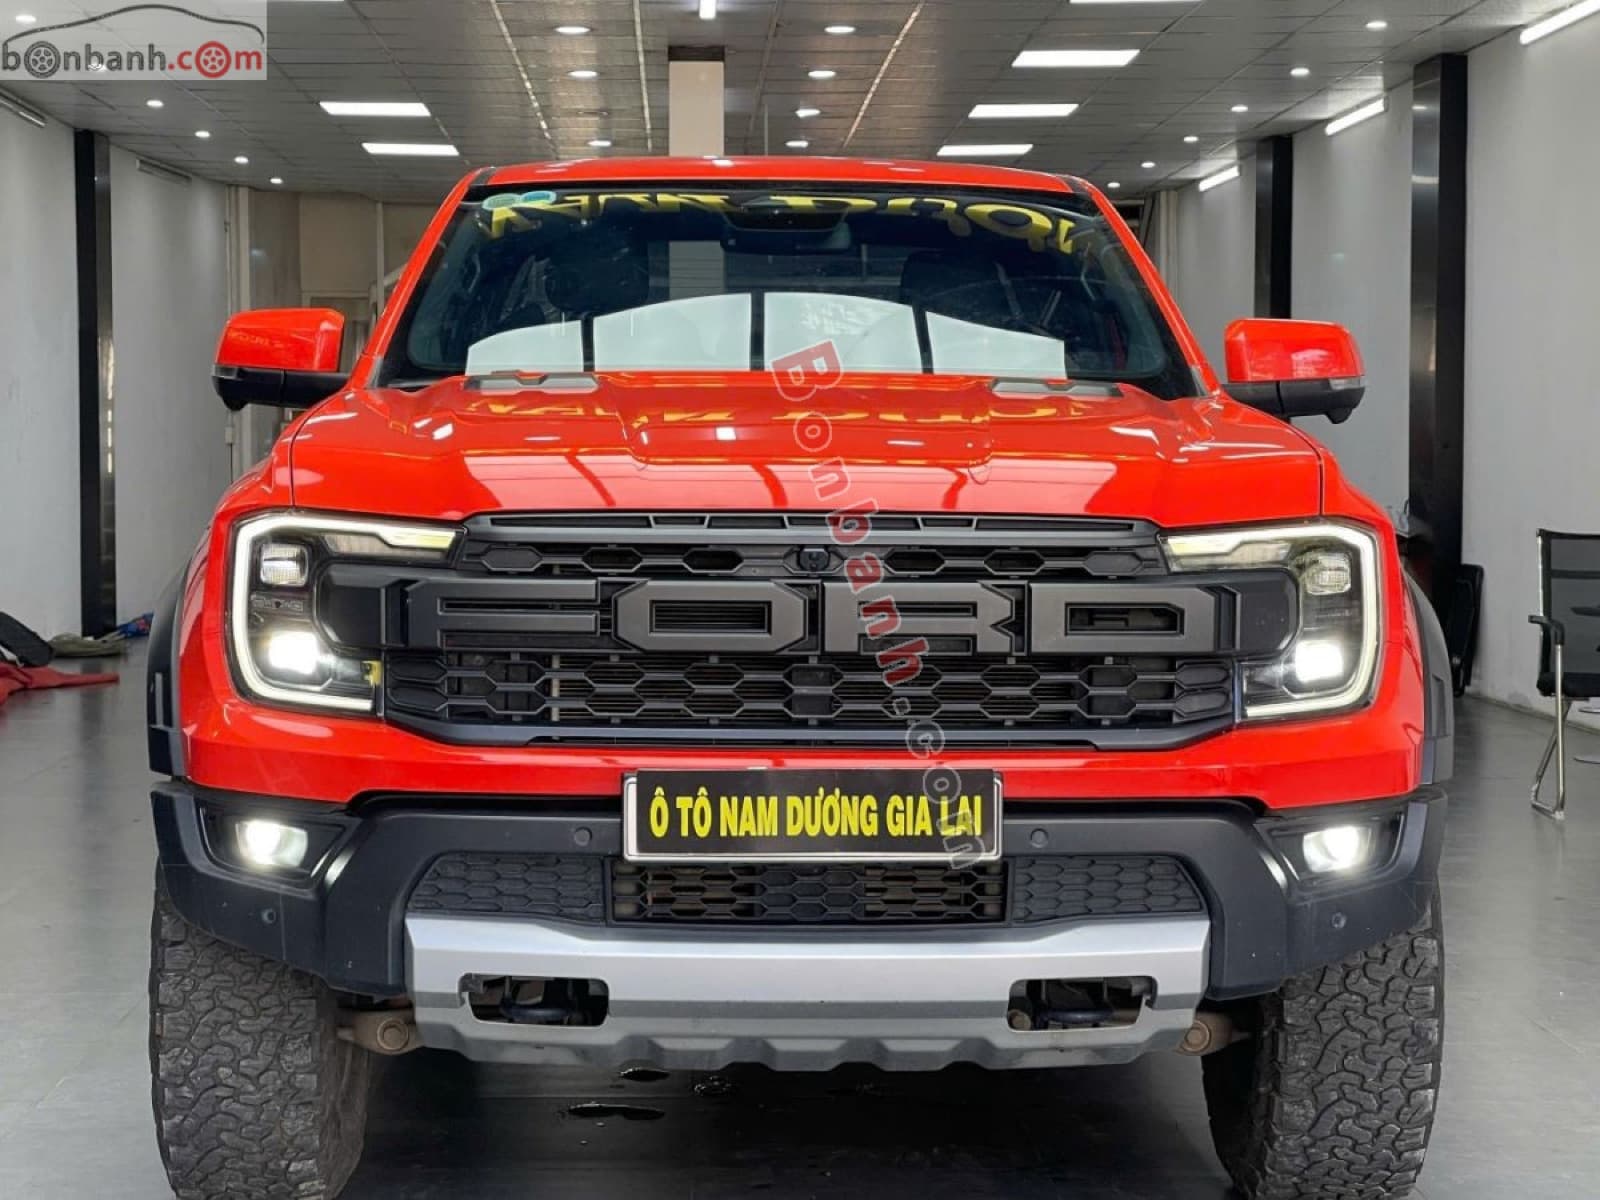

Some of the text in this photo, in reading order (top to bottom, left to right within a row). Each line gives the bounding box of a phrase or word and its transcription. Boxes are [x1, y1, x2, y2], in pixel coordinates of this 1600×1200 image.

[405, 577, 1218, 655] FORD
[649, 786, 982, 838] Ô TÔ NAM DƯƠNG GIA LAI
